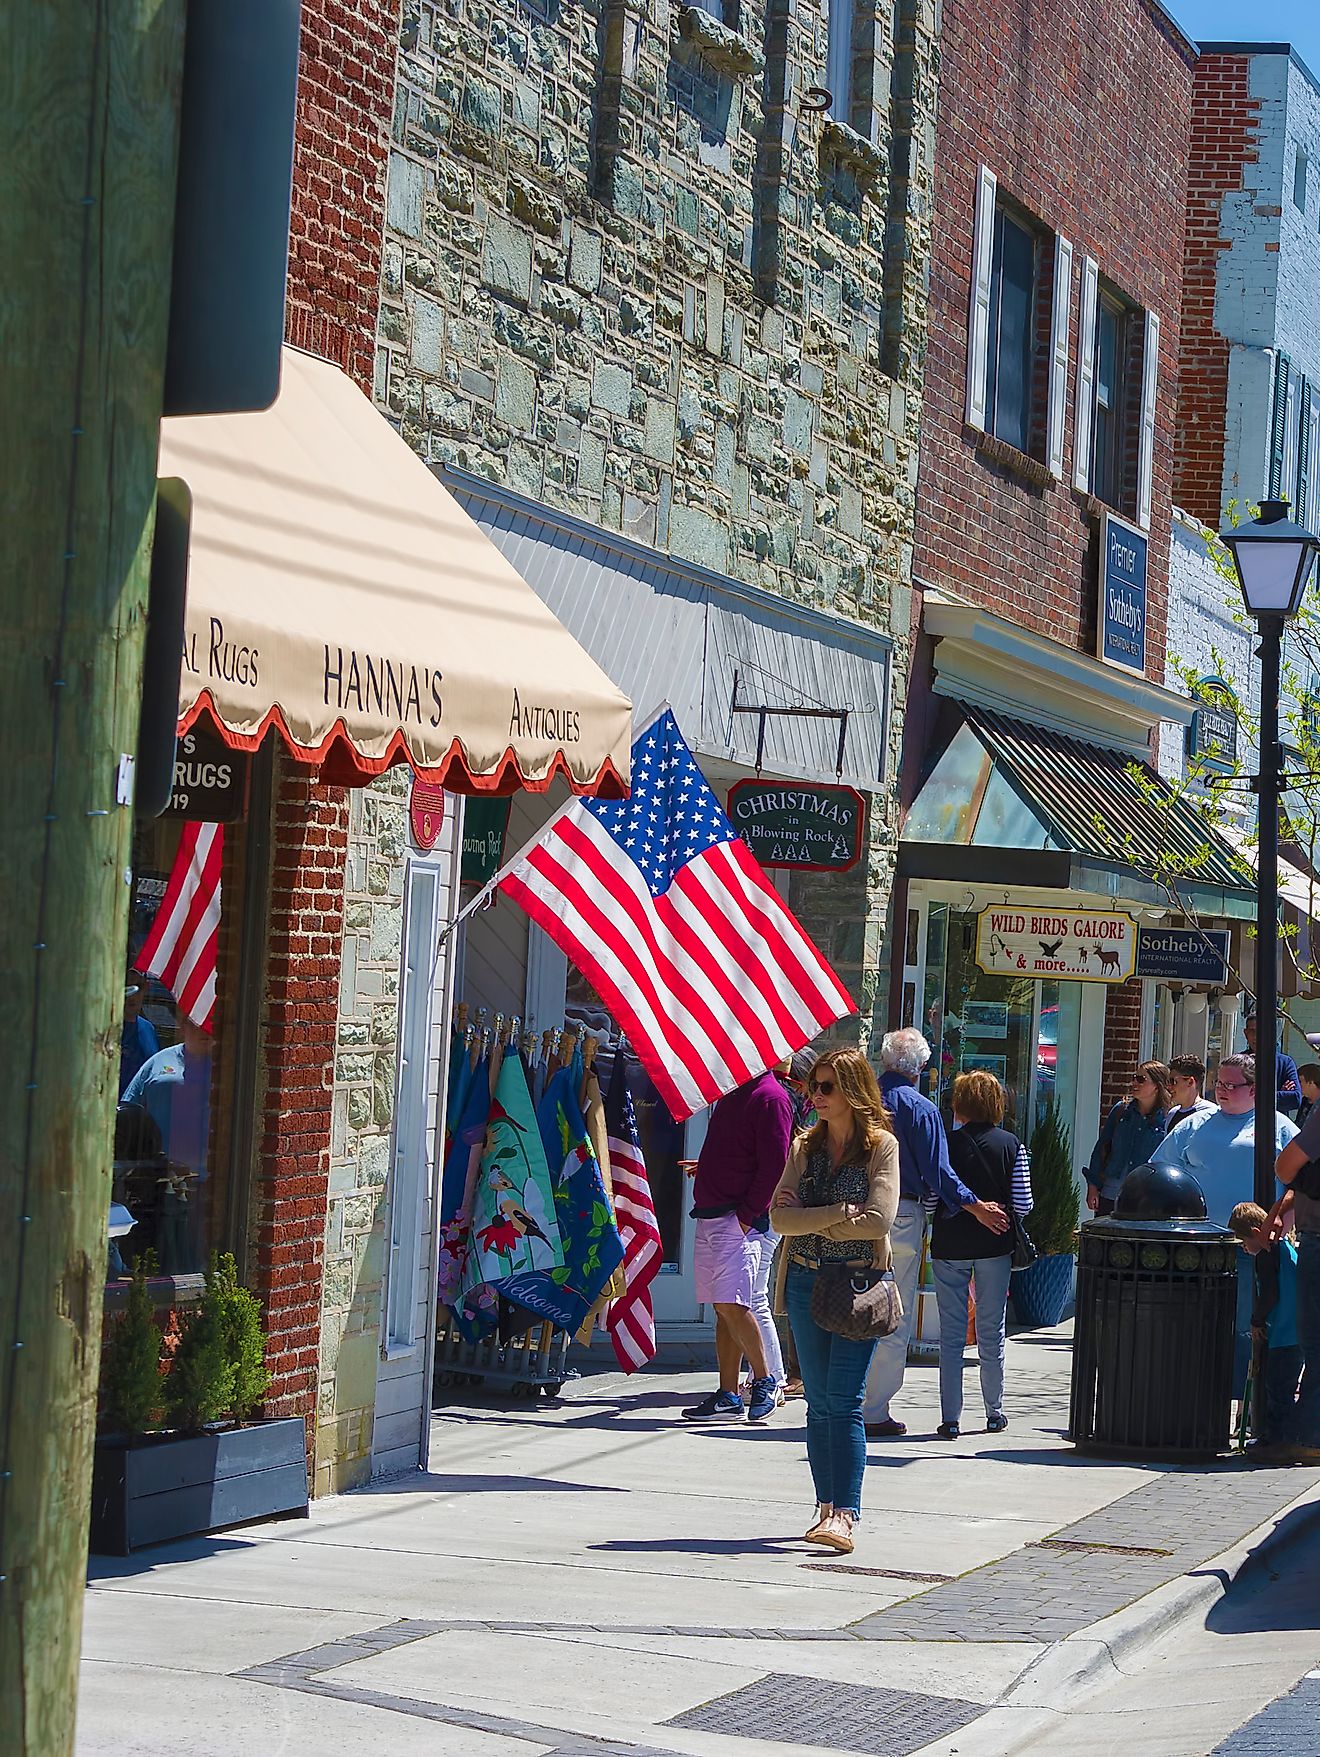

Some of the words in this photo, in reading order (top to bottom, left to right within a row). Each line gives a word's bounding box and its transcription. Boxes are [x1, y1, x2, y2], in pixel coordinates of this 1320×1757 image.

[1110, 532, 1138, 574] Premier
[1108, 588, 1142, 638] Sotheby's
[323, 644, 443, 728] HANNA'S
[173, 762, 232, 789] RUGS
[736, 791, 853, 826] CHRISTMAS
[751, 825, 800, 843] Blowing
[805, 828, 834, 843] Rock
[991, 914, 1026, 933] WILD
[1031, 917, 1068, 937] BIRDS
[1073, 919, 1126, 940] GALORE
[1016, 954, 1027, 969] &
[1140, 954, 1191, 963] INTERNATIONAL
[1194, 957, 1217, 965] REALTY
[498, 1274, 572, 1323] Welcome
